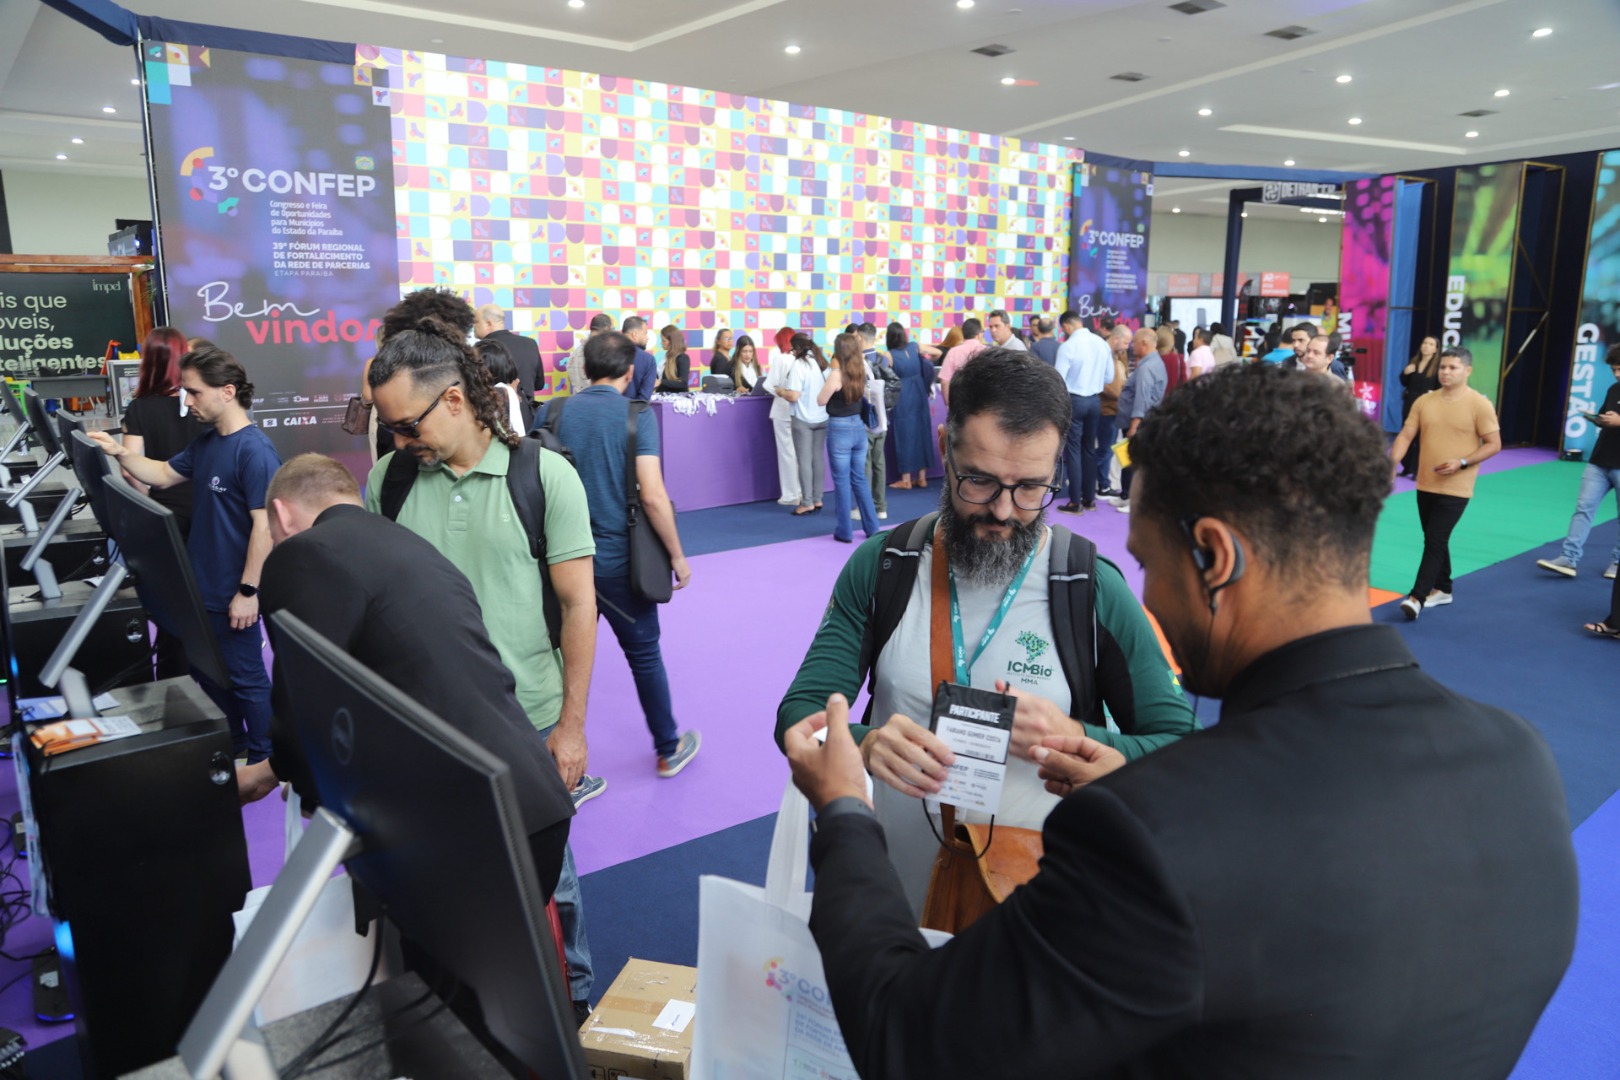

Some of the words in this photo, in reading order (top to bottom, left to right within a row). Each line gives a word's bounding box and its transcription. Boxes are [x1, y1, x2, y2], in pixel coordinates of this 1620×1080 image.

[242, 168, 376, 198] CONFEP
[269, 200, 304, 210] Congresso
[311, 201, 328, 209] Feira
[270, 209, 280, 217] de
[281, 210, 331, 219] Oportunidades
[271, 219, 287, 227] para
[289, 218, 325, 229] Municípios
[271, 226, 281, 234] do
[282, 227, 306, 235] Estado
[307, 228, 317, 236] da
[318, 228, 343, 236] Paraíba
[289, 241, 320, 250] FÓRUM
[321, 243, 365, 252] REGIONAL
[1099, 232, 1145, 249] CONFEP
[273, 251, 285, 259] DE
[287, 252, 363, 260] FORTALECIMENTO
[274, 261, 286, 269] DA
[288, 261, 310, 269] REDE
[312, 261, 323, 269] DE
[325, 261, 370, 270] PARCERIAS
[0, 292, 18, 309] is
[23, 295, 68, 314] que
[197, 281, 320, 322] Bem
[1078, 294, 1119, 319] Bem
[1442, 275, 1466, 353] EDUC
[1564, 322, 1600, 438] GESTÃO
[283, 415, 317, 426] CAIXA
[1007, 660, 1053, 677] ICMBio
[1021, 677, 1039, 686] MMA
[949, 704, 1001, 724] PARTICIPANTE
